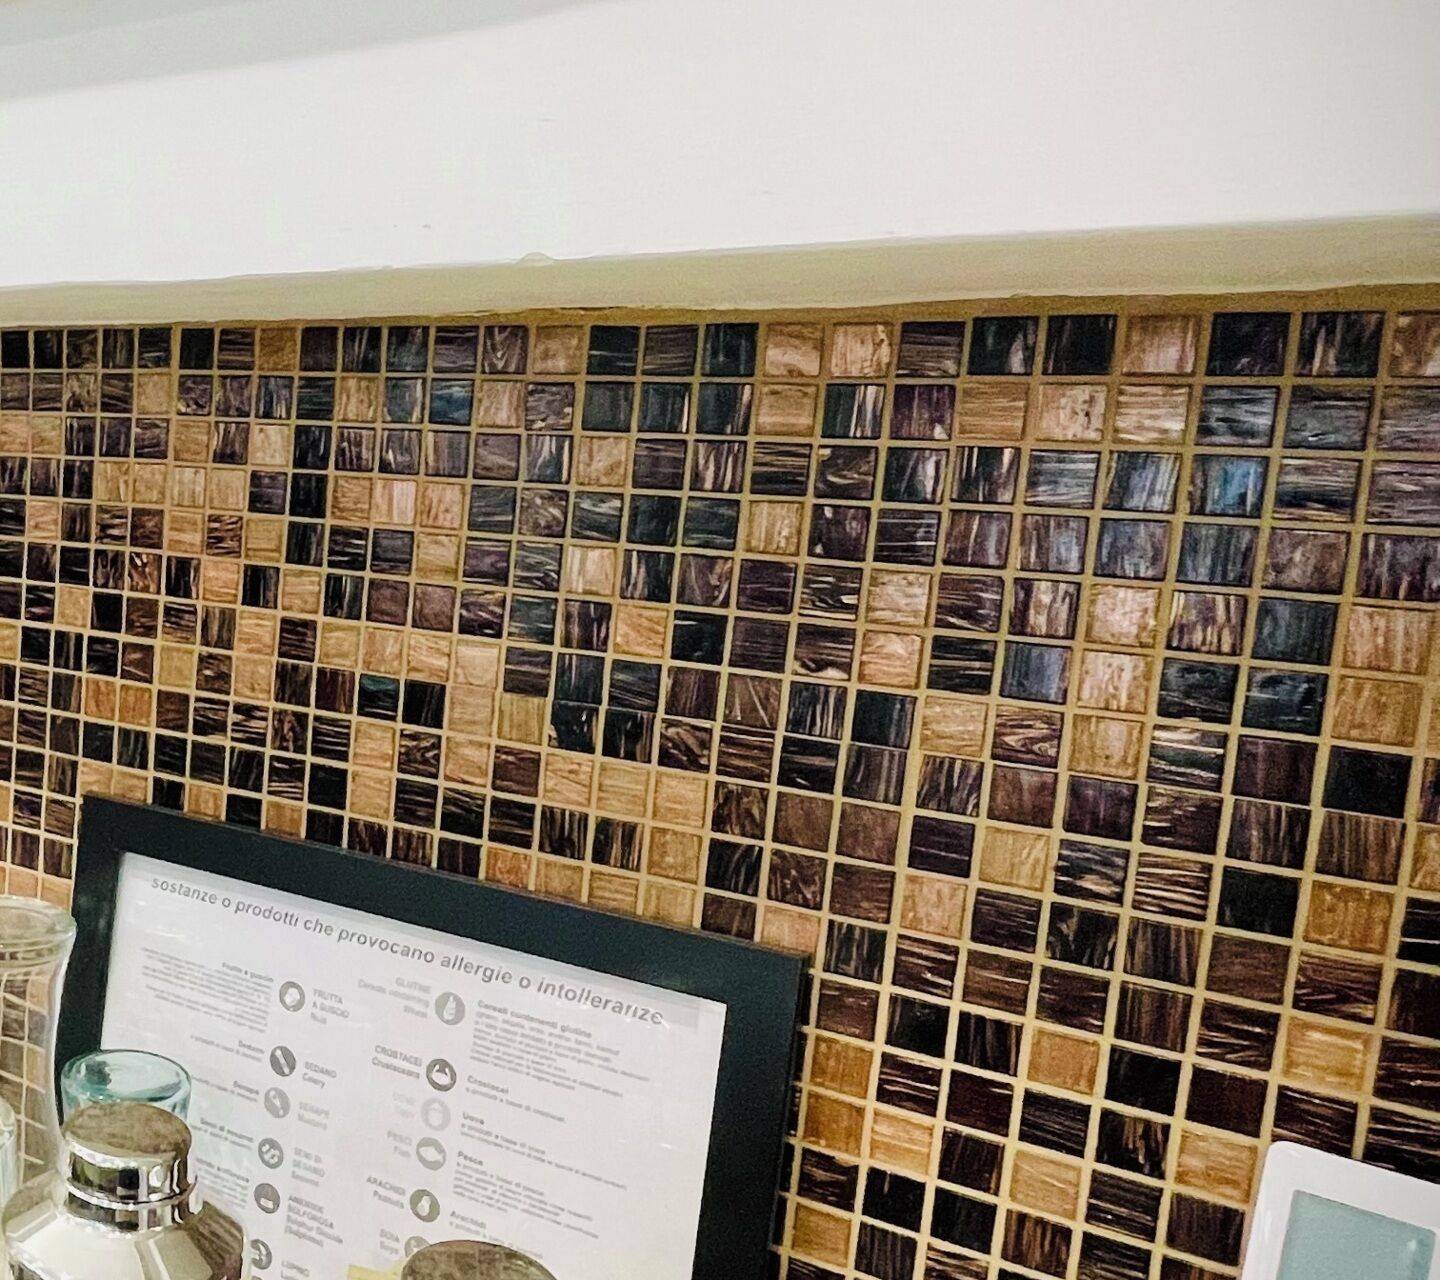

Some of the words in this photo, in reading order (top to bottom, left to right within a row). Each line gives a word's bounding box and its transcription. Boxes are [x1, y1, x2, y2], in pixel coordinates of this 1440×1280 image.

[152, 876, 217, 905] sostanze
[221, 897, 231, 908] o
[234, 900, 299, 928] prodotti
[303, 916, 334, 937] che
[337, 927, 435, 964] provocano
[440, 954, 513, 984] allergie
[519, 976, 531, 989] o
[537, 977, 665, 1026] intolleranze
